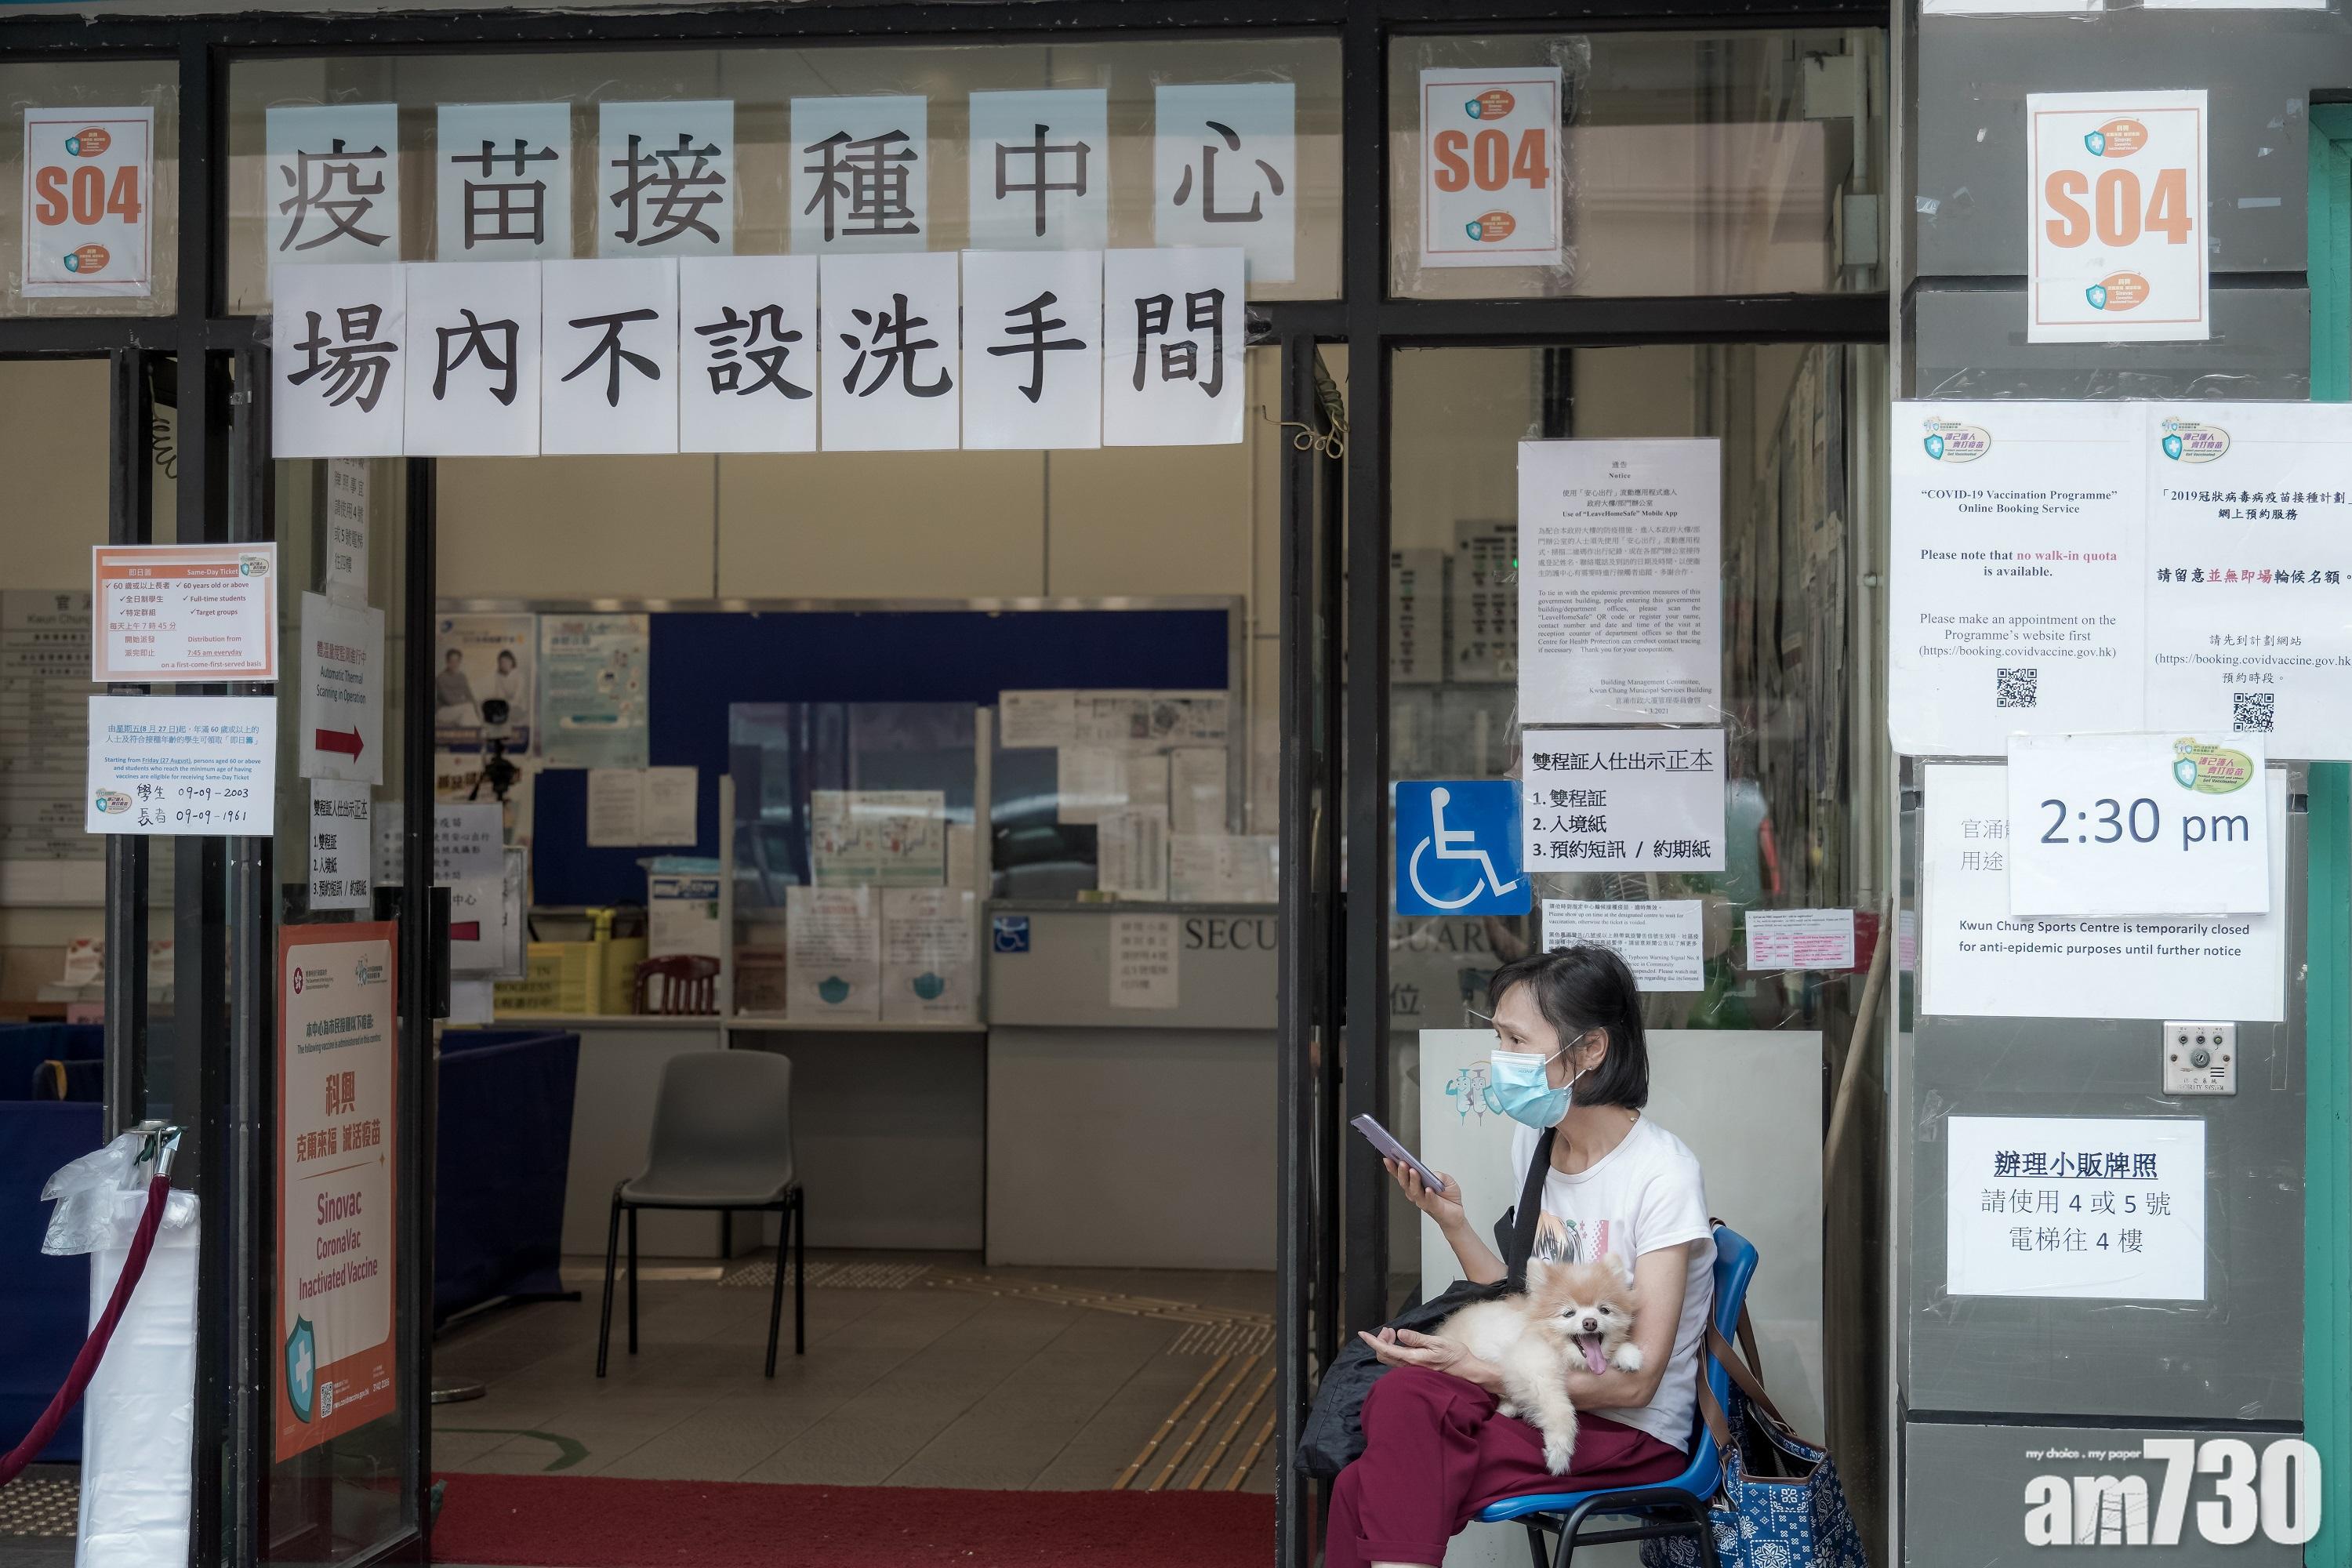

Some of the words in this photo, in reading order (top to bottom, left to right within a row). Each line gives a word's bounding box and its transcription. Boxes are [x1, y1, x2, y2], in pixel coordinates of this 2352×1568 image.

[1433, 128, 1550, 194] S04
[279, 121, 1283, 251] 疫苗接種中心
[34, 165, 142, 226] S04
[2044, 168, 2193, 249] S04
[287, 288, 1225, 412] 場內不設洗手間
[1998, 504, 2038, 515] Booking
[2042, 504, 2079, 513] Service
[2219, 509, 2298, 520] 網上預約服務
[1921, 550, 1957, 559] Please
[1962, 551, 1985, 560] note
[1991, 550, 2013, 560] that
[2035, 551, 2078, 560] walk-in
[2083, 552, 2116, 563] quota
[220, 568, 239, 577] Ticket
[1984, 566, 1992, 575] is
[1997, 567, 2052, 576] available.
[2157, 568, 2351, 584] 請留意並無即場輪候名額。
[1921, 614, 1955, 623] Please
[1959, 614, 1988, 623] make
[2009, 615, 2078, 626] appointment
[2100, 615, 2115, 625] the
[2023, 630, 2064, 640] website
[2070, 630, 2089, 641] first
[2209, 634, 2301, 646] 請先到計劃網站
[125, 649, 154, 658] 派完即止
[1919, 646, 2115, 659] (https://booking.covidvaccine.gov.hk)
[247, 660, 263, 669] basis
[320, 666, 345, 681] Automatic
[344, 670, 363, 684] Thermal
[2223, 672, 2283, 684] 預約時段。
[315, 684, 338, 702] Scanning
[338, 689, 343, 701] in
[343, 689, 365, 703] Operation
[1532, 749, 1713, 771] 雙程証人仕出示正本
[137, 783, 165, 801] 學生
[179, 787, 248, 800] 09-09-2003
[1550, 789, 1606, 808] 雙程証
[138, 808, 165, 826] 長者
[176, 809, 245, 824] 09-09-1961
[314, 799, 367, 819] 雙程証人仕出示正本
[1550, 815, 1606, 833] 入境紙
[1962, 819, 2009, 839] 官涌
[2042, 798, 2159, 843] 2:30
[2183, 815, 2248, 851] pm
[318, 833, 336, 851] 雙程証
[1550, 840, 1625, 858] 預約短訊
[1653, 840, 1711, 858] 約期紙
[1962, 851, 2002, 870] 用途
[318, 880, 342, 896] 預約短訊
[350, 880, 366, 896] 約期紙
[1960, 920, 1992, 930] Kwun
[1997, 919, 2035, 933] Chung
[2038, 922, 2075, 933] Sports
[2080, 923, 2119, 932] Centre
[2124, 923, 2132, 932] is
[2136, 924, 2207, 935] temporarily
[2212, 924, 2249, 934] closed
[1959, 942, 1976, 951] for
[1980, 942, 2062, 954] anti-epidemic
[2067, 946, 2121, 956] purposes
[2126, 945, 2152, 954] until
[2157, 945, 2200, 955] further
[2204, 946, 2241, 956] notice
[325, 1070, 356, 1117] 科興
[296, 1127, 336, 1163] 克爾來福
[342, 1119, 381, 1152] 滅活疫苗
[1994, 1151, 2158, 1180] 辦理小販牌照
[318, 1192, 361, 1225] Sinovac
[1982, 1189, 2058, 1214] 請使用
[2069, 1195, 2082, 1211] 4
[2091, 1191, 2115, 1214] 或
[2125, 1196, 2136, 1213] 5
[2146, 1192, 2170, 1216] 號
[317, 1228, 361, 1261] CoronaVac
[2009, 1227, 2087, 1251] 電梯往
[2096, 1233, 2109, 1250] 4
[2118, 1229, 2143, 1253] 樓
[299, 1262, 347, 1300] Inactivated
[347, 1256, 377, 1283] Vaccine
